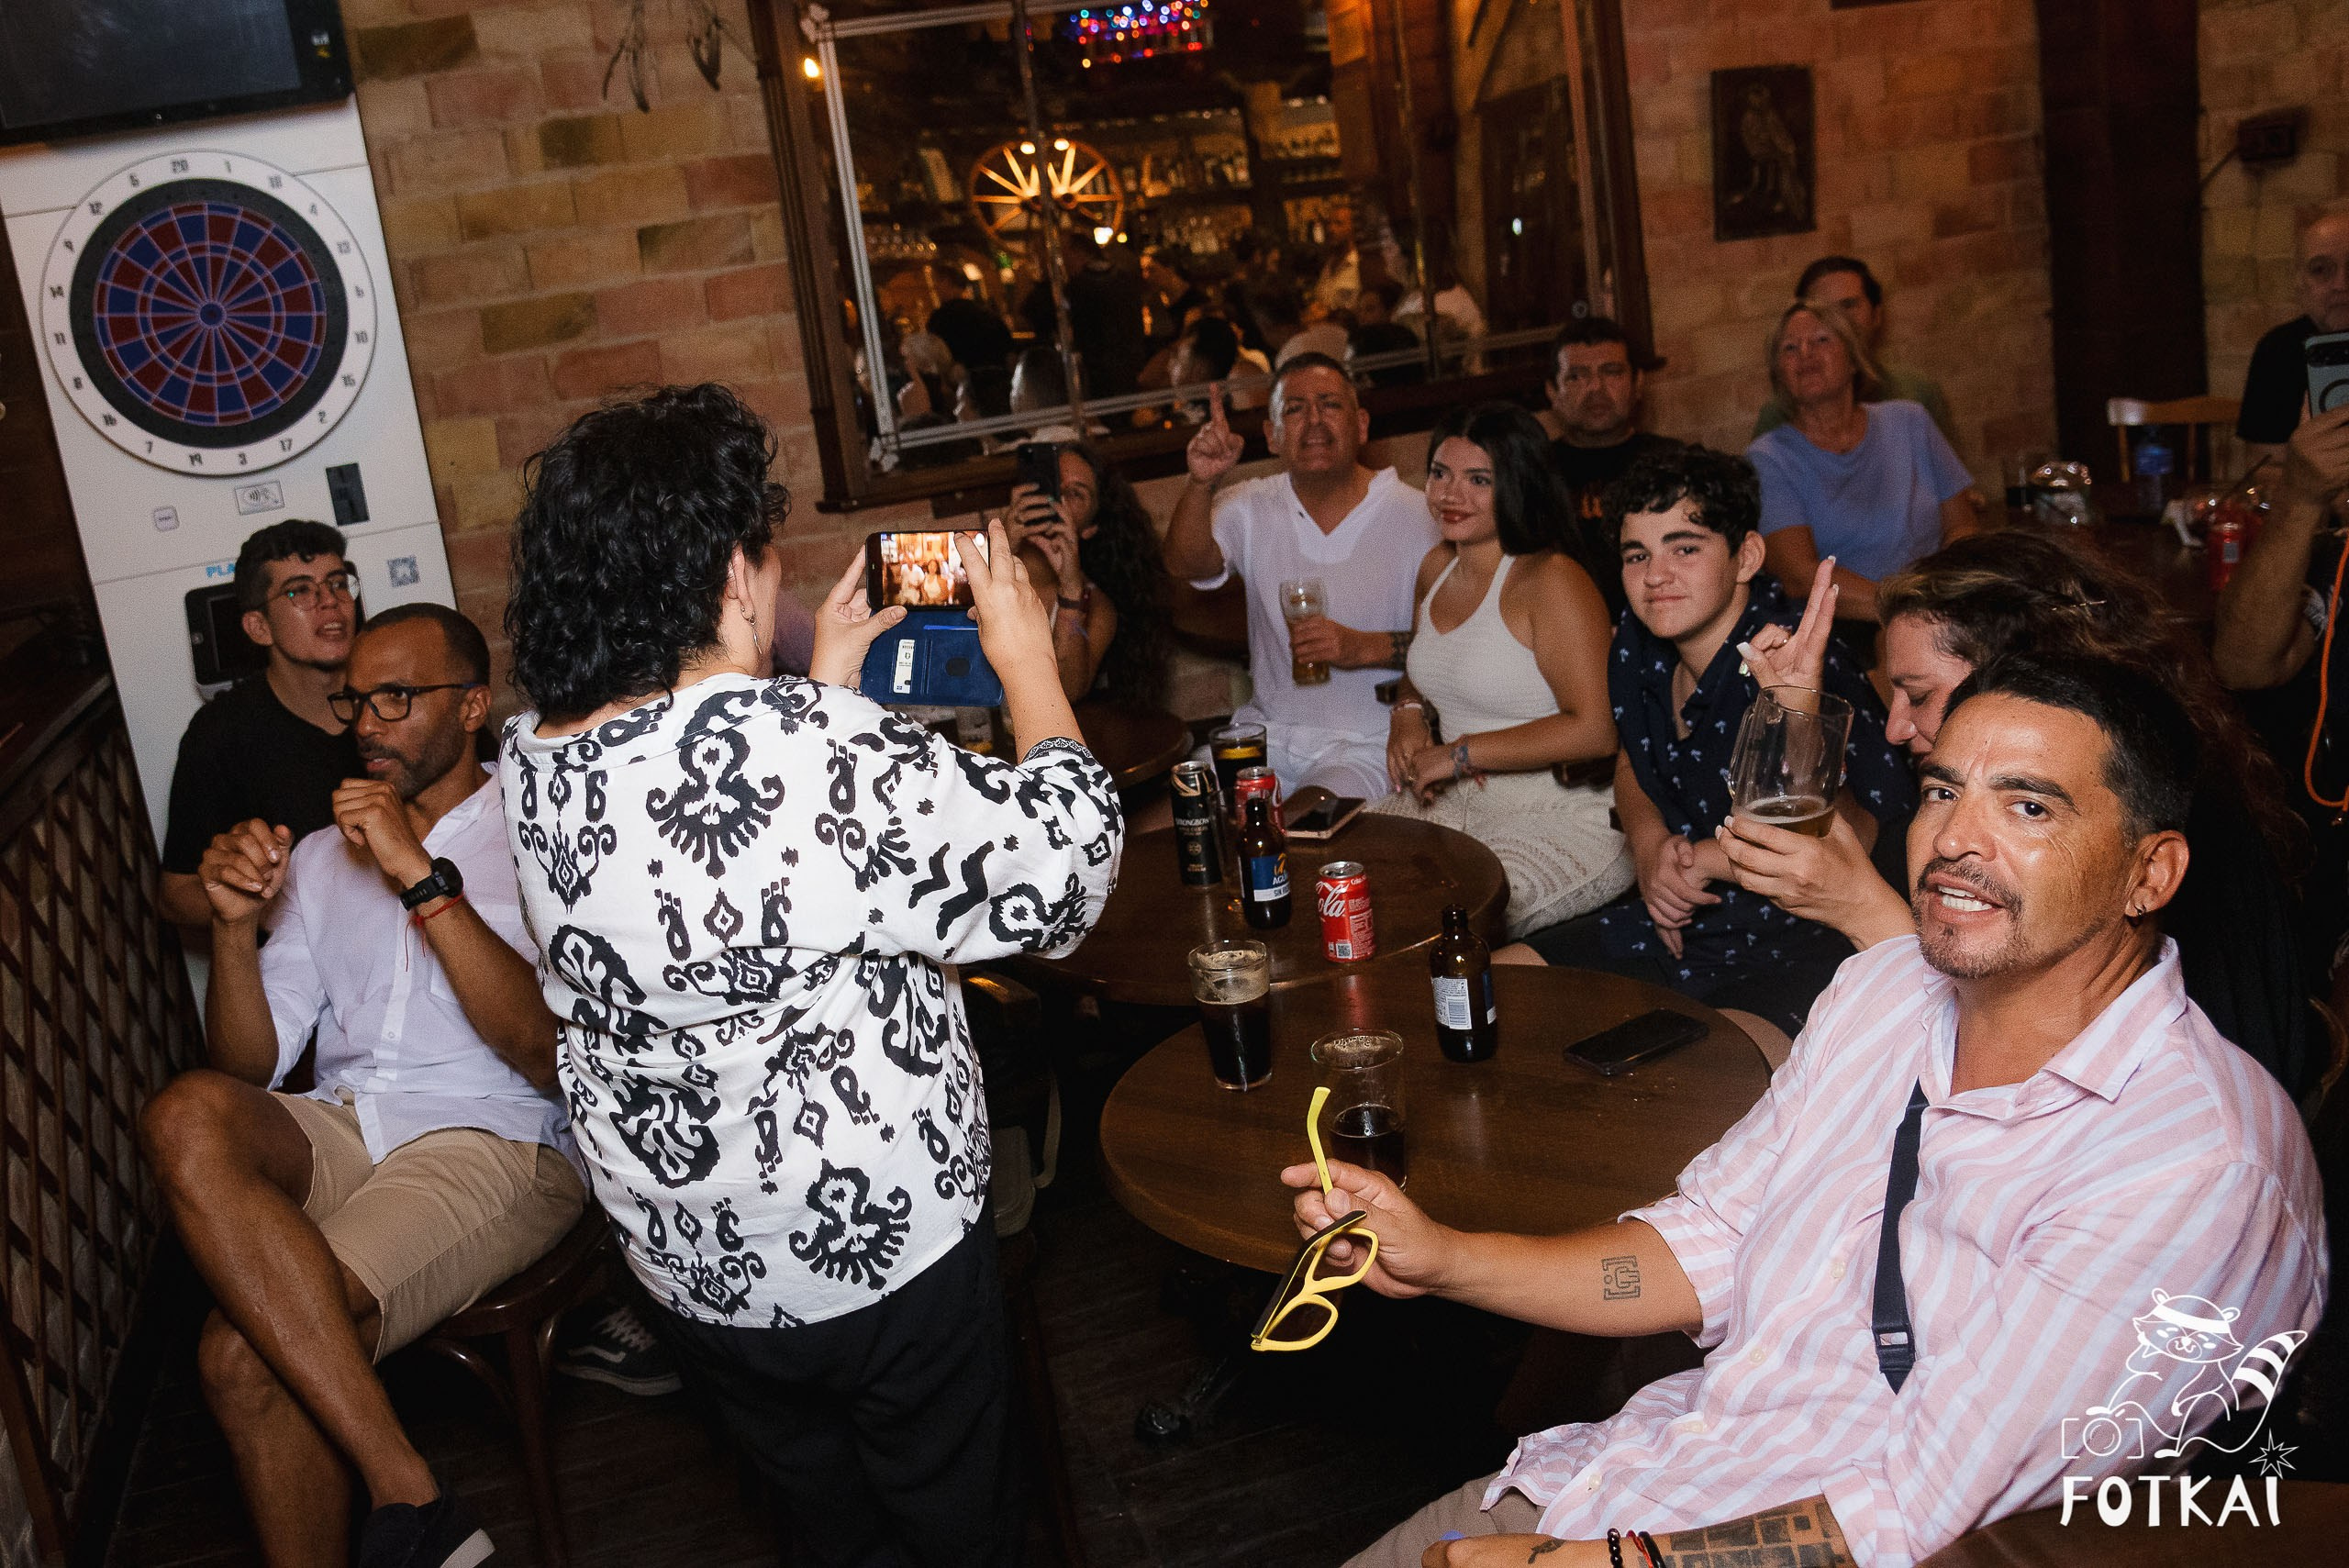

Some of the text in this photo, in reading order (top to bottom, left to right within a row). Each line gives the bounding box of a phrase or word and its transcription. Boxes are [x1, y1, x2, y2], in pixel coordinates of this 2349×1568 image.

[171, 160, 189, 173] 20
[225, 161, 232, 173] 1
[63, 239, 75, 253] 9
[50, 285, 64, 298] 14
[54, 332, 67, 346] 11
[72, 375, 83, 391] 8
[317, 410, 328, 424] 2
[145, 440, 153, 454] 7
[279, 438, 293, 452] 17
[188, 452, 204, 466] 19
[238, 452, 249, 466] 3
[205, 562, 236, 579] PLA
